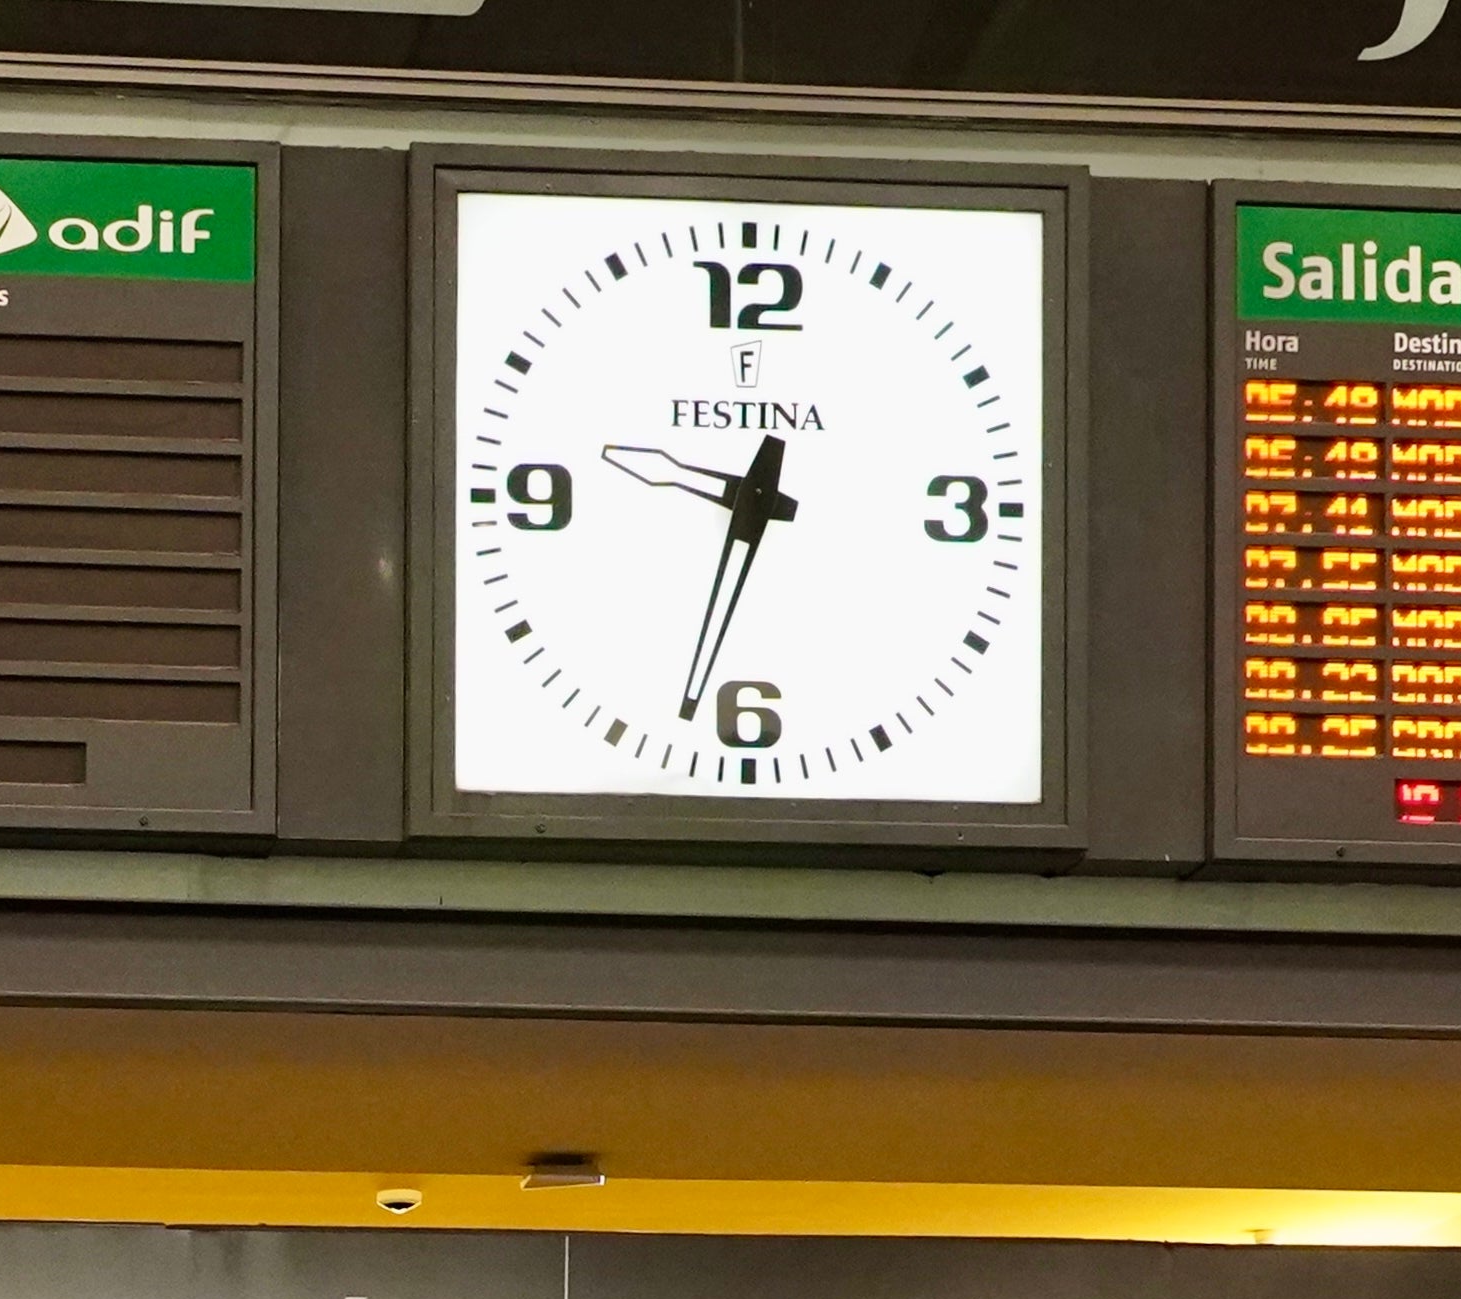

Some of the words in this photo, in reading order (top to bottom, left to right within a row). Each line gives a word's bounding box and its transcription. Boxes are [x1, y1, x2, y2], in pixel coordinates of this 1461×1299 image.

[48, 205, 214, 253] adif
[693, 261, 804, 331] 12
[1245, 331, 1299, 353] Hora
[1245, 357, 1277, 371] TIME
[671, 399, 825, 431] FESTINA
[506, 463, 573, 531] 9
[924, 475, 989, 543] 3
[716, 680, 782, 748] 6
